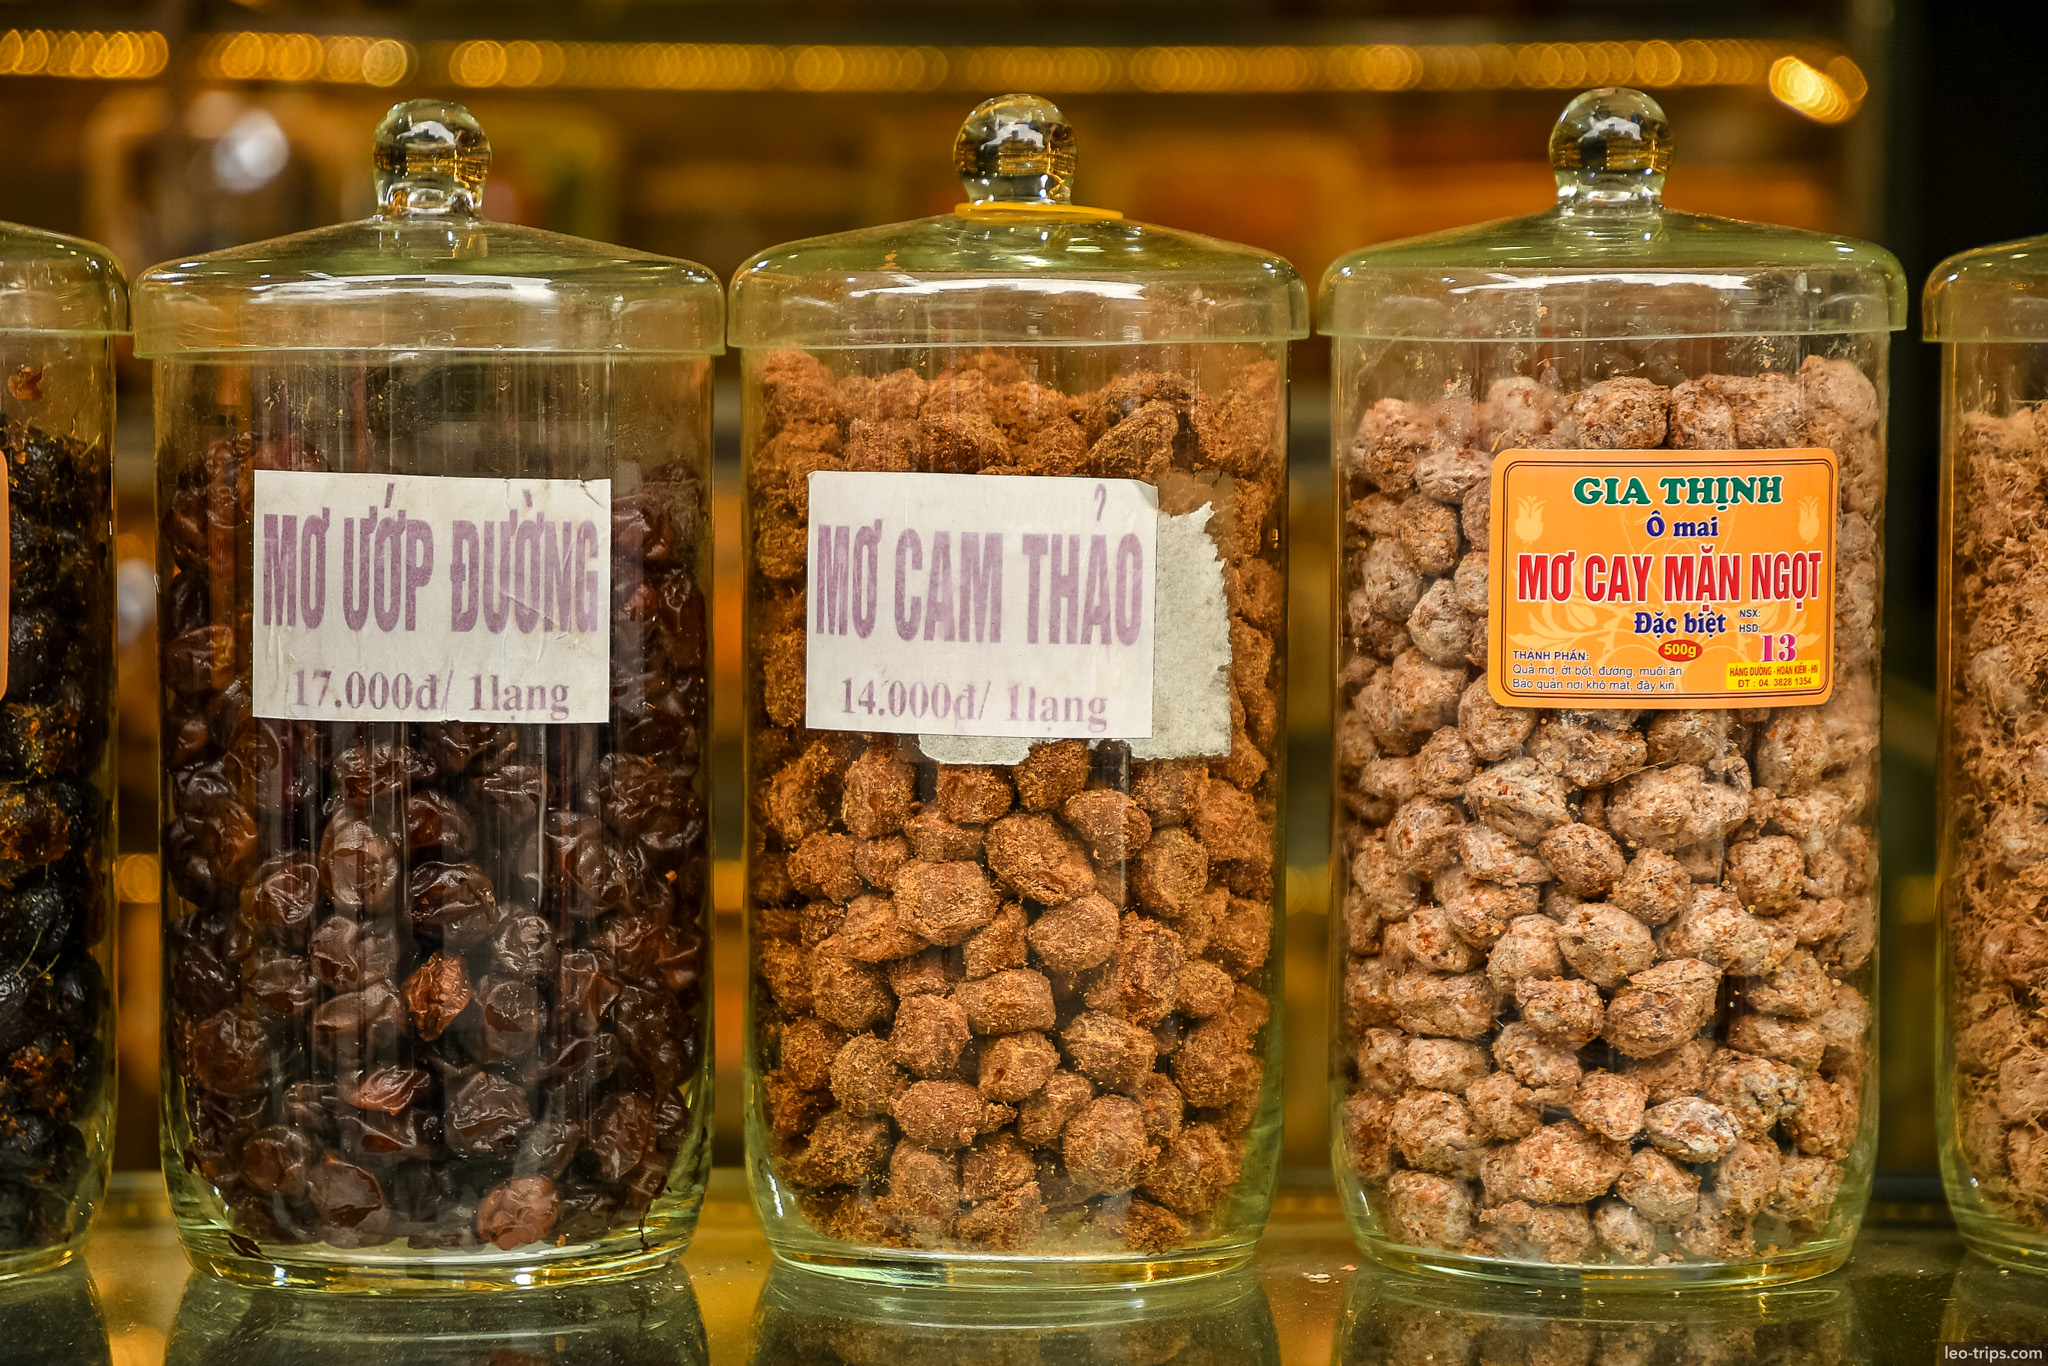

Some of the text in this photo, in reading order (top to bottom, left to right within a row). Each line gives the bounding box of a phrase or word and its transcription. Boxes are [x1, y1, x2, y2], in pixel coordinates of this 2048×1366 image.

[1573, 476, 1783, 511] GIA THỊNH
[1646, 511, 1719, 537] Ô mai
[263, 482, 598, 634] MƠ ƯỚP ĐƯỜNG
[816, 483, 1143, 646] MƠ CAM THẢO
[1517, 545, 1822, 612] MƠ CAY MẶN NGỌT
[1634, 611, 1726, 638] Đặc biệt
[1739, 609, 1761, 617] NSX:
[1739, 624, 1761, 632] HSD:
[1513, 648, 1551, 660] THÀNH
[1664, 644, 1697, 658] 500g
[1760, 634, 1796, 662] 13
[1512, 663, 1534, 675] Quả
[1640, 665, 1666, 676] muối
[1669, 666, 1682, 676] ăn
[1729, 665, 1748, 676] HÀNG
[1738, 679, 1750, 688] ĐT
[1774, 678, 1792, 686] 3828
[1795, 677, 1812, 685] 1354
[293, 668, 453, 712] 17.000đ/
[1512, 677, 1533, 688] Bảo
[1537, 678, 1563, 691] quản
[1586, 679, 1606, 689] khô
[1636, 680, 1656, 692] đậy
[841, 680, 991, 722] 14.000đ/
